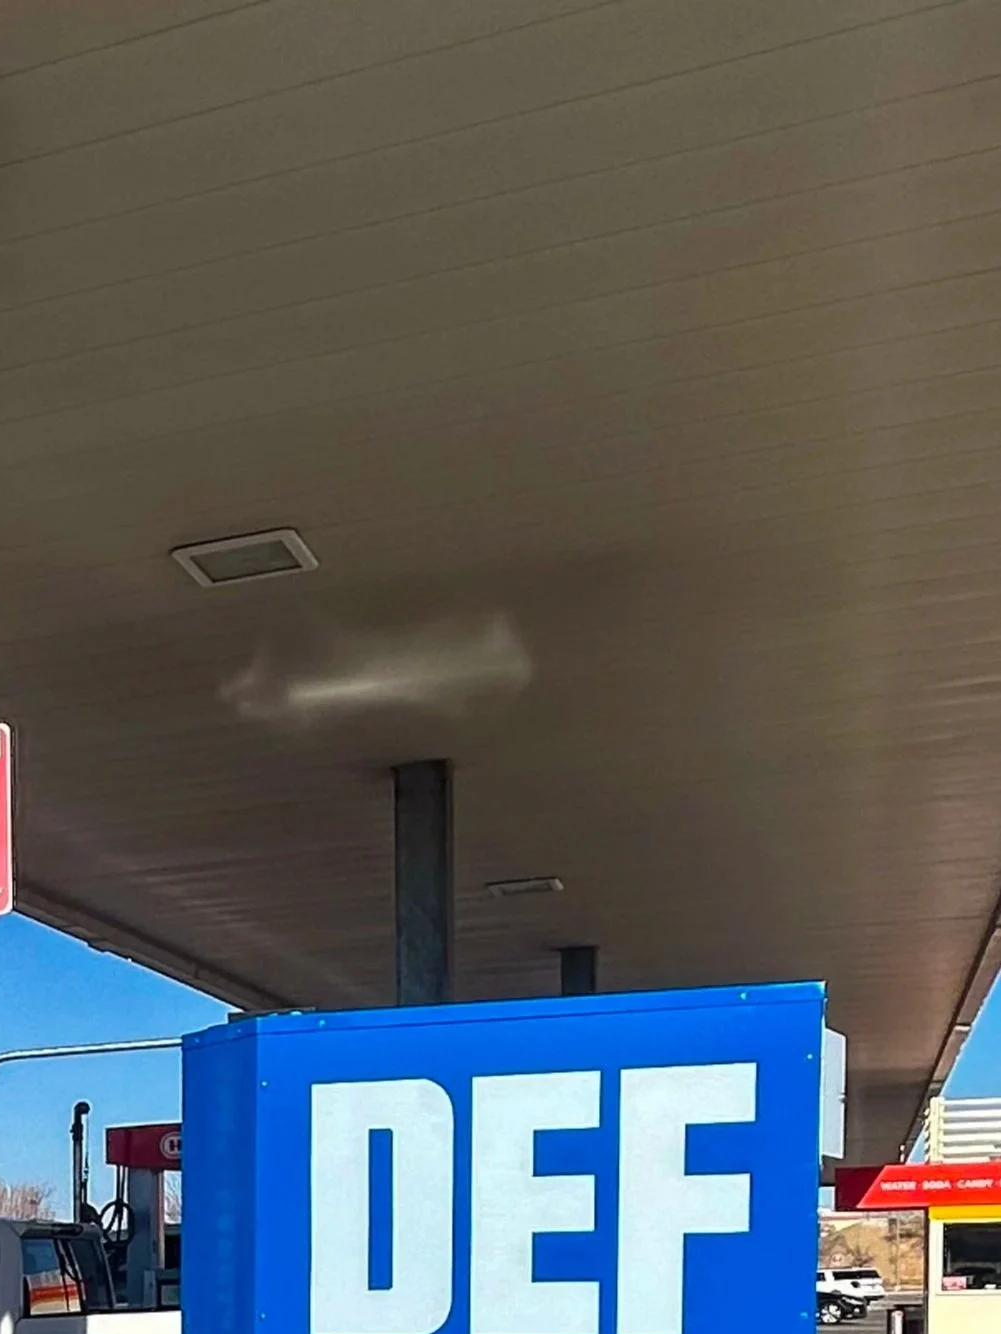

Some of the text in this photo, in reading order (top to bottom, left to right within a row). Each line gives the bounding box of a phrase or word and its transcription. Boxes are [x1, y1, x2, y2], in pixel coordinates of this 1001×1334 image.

[880, 1178, 994, 1192] WATER SODA CANDY
